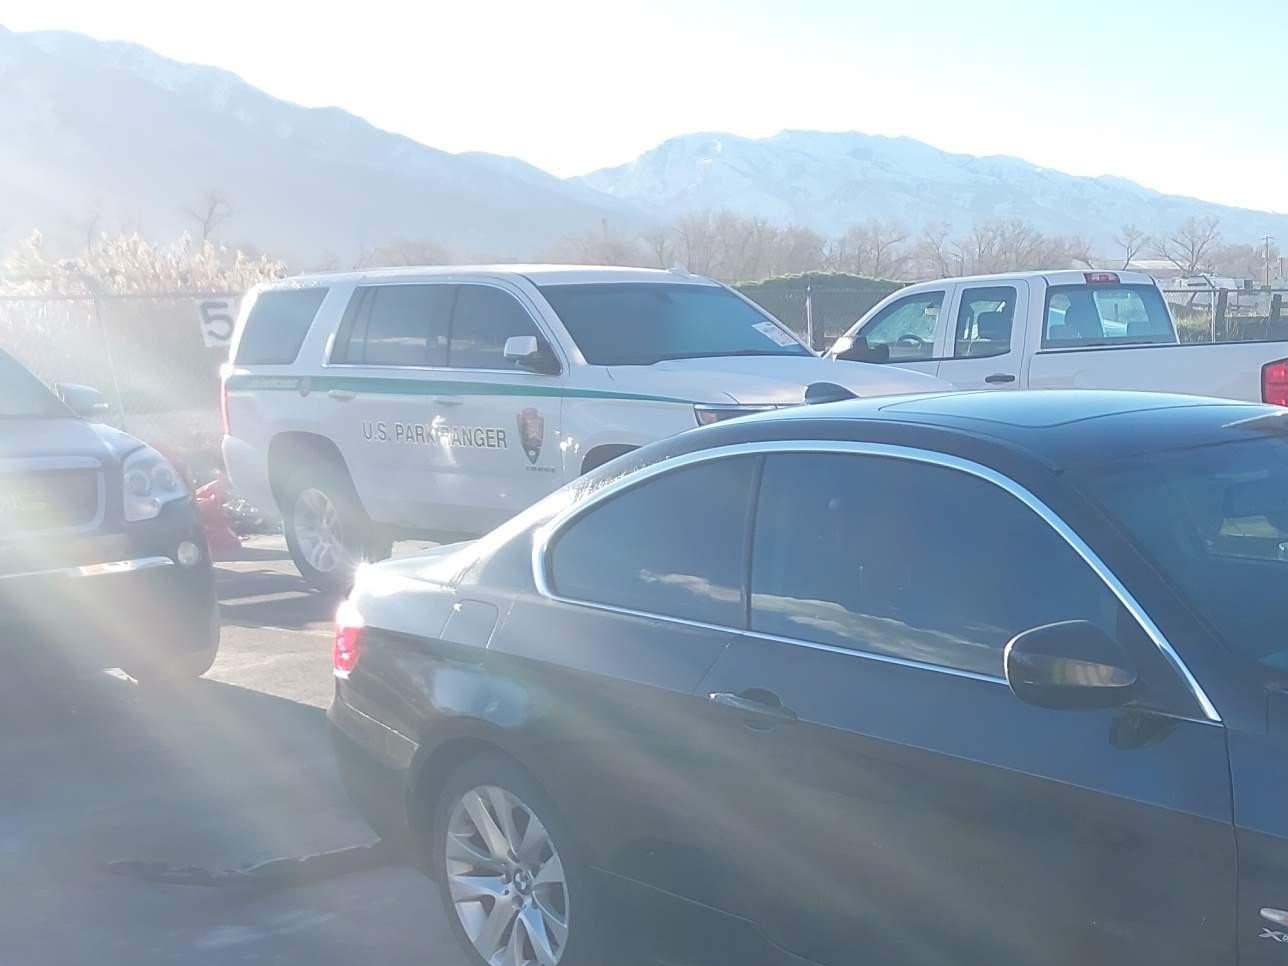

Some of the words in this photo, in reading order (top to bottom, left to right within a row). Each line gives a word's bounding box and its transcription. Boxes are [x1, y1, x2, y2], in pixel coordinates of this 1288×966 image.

[200, 301, 234, 341] 5
[362, 422, 391, 441] U.S.
[395, 423, 435, 443] PARK
